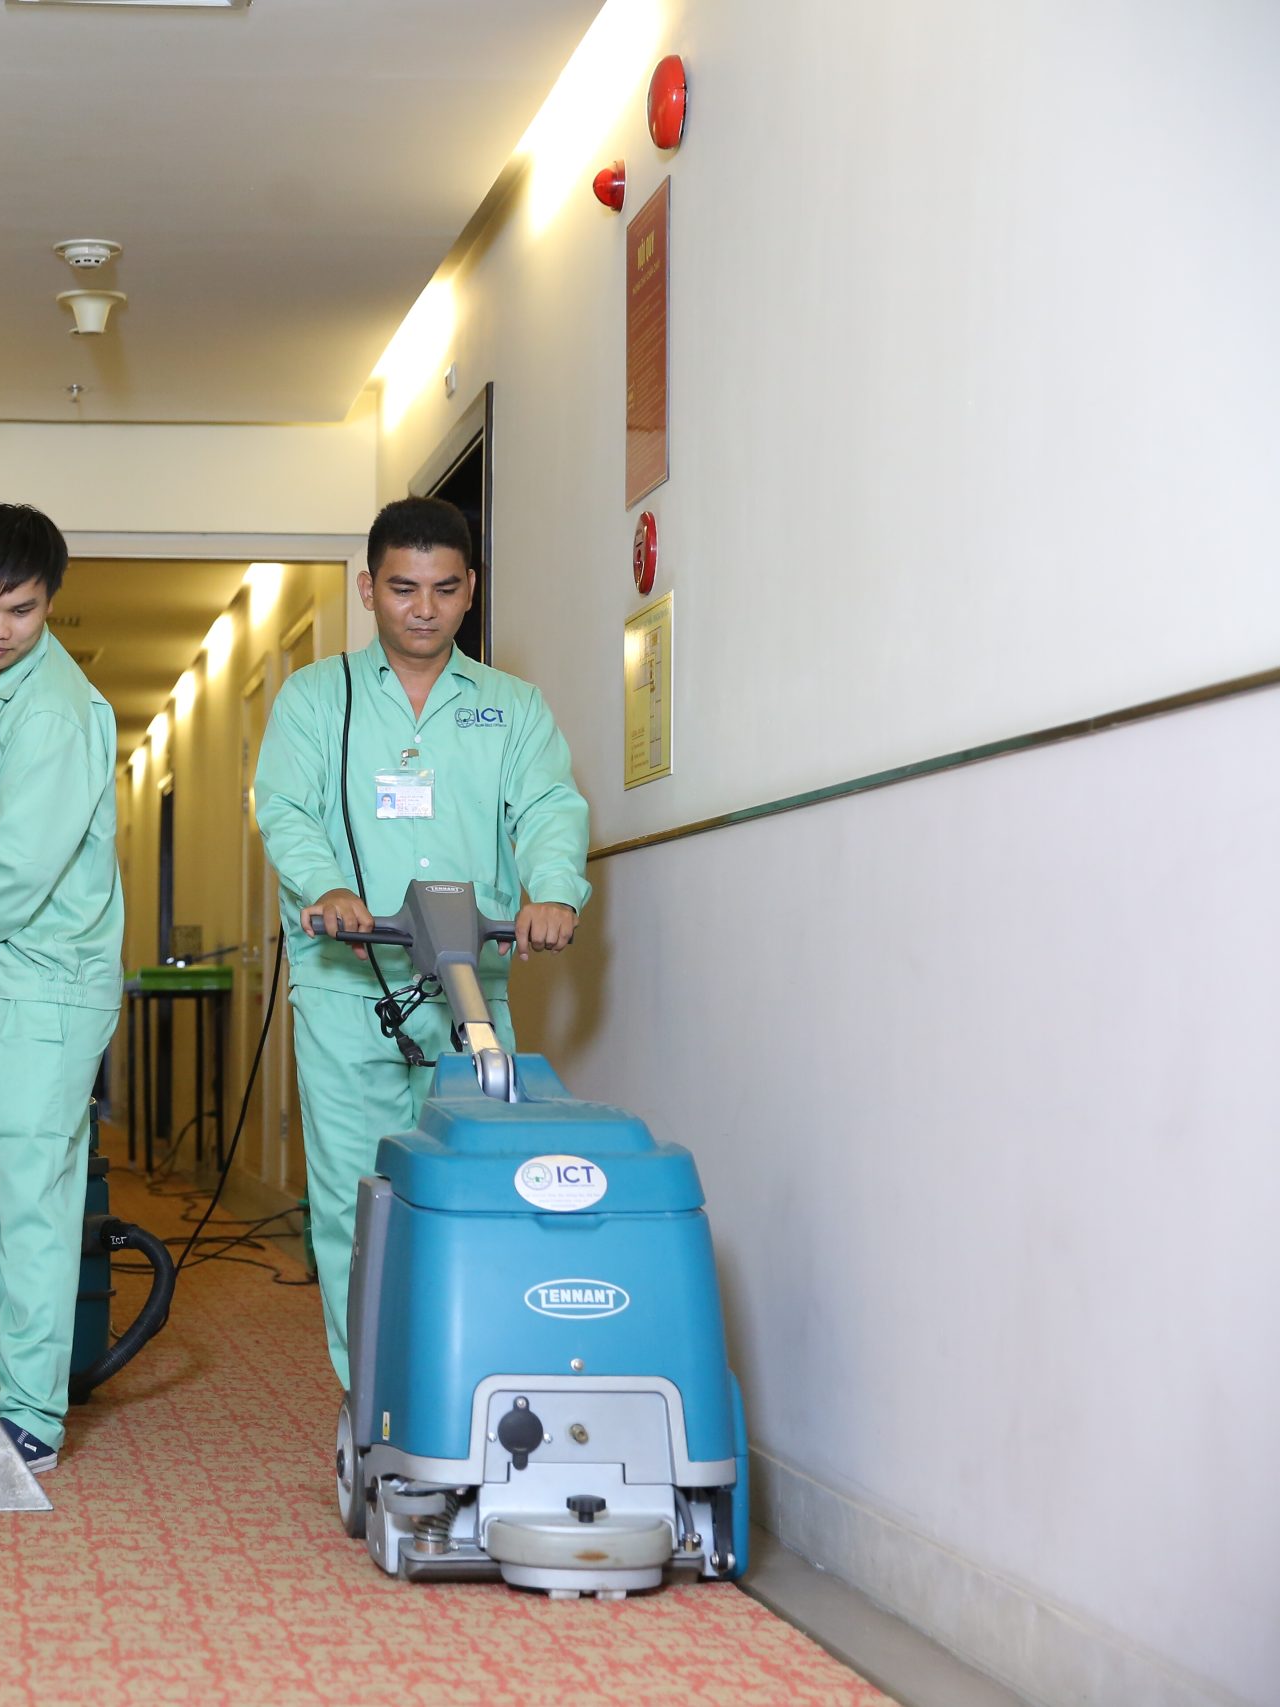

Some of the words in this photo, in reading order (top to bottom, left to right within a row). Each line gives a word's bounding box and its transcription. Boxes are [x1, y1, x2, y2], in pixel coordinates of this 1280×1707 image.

[475, 707, 504, 723] ICT
[556, 1165, 595, 1183] ICT
[538, 1288, 616, 1308] TENNANT
